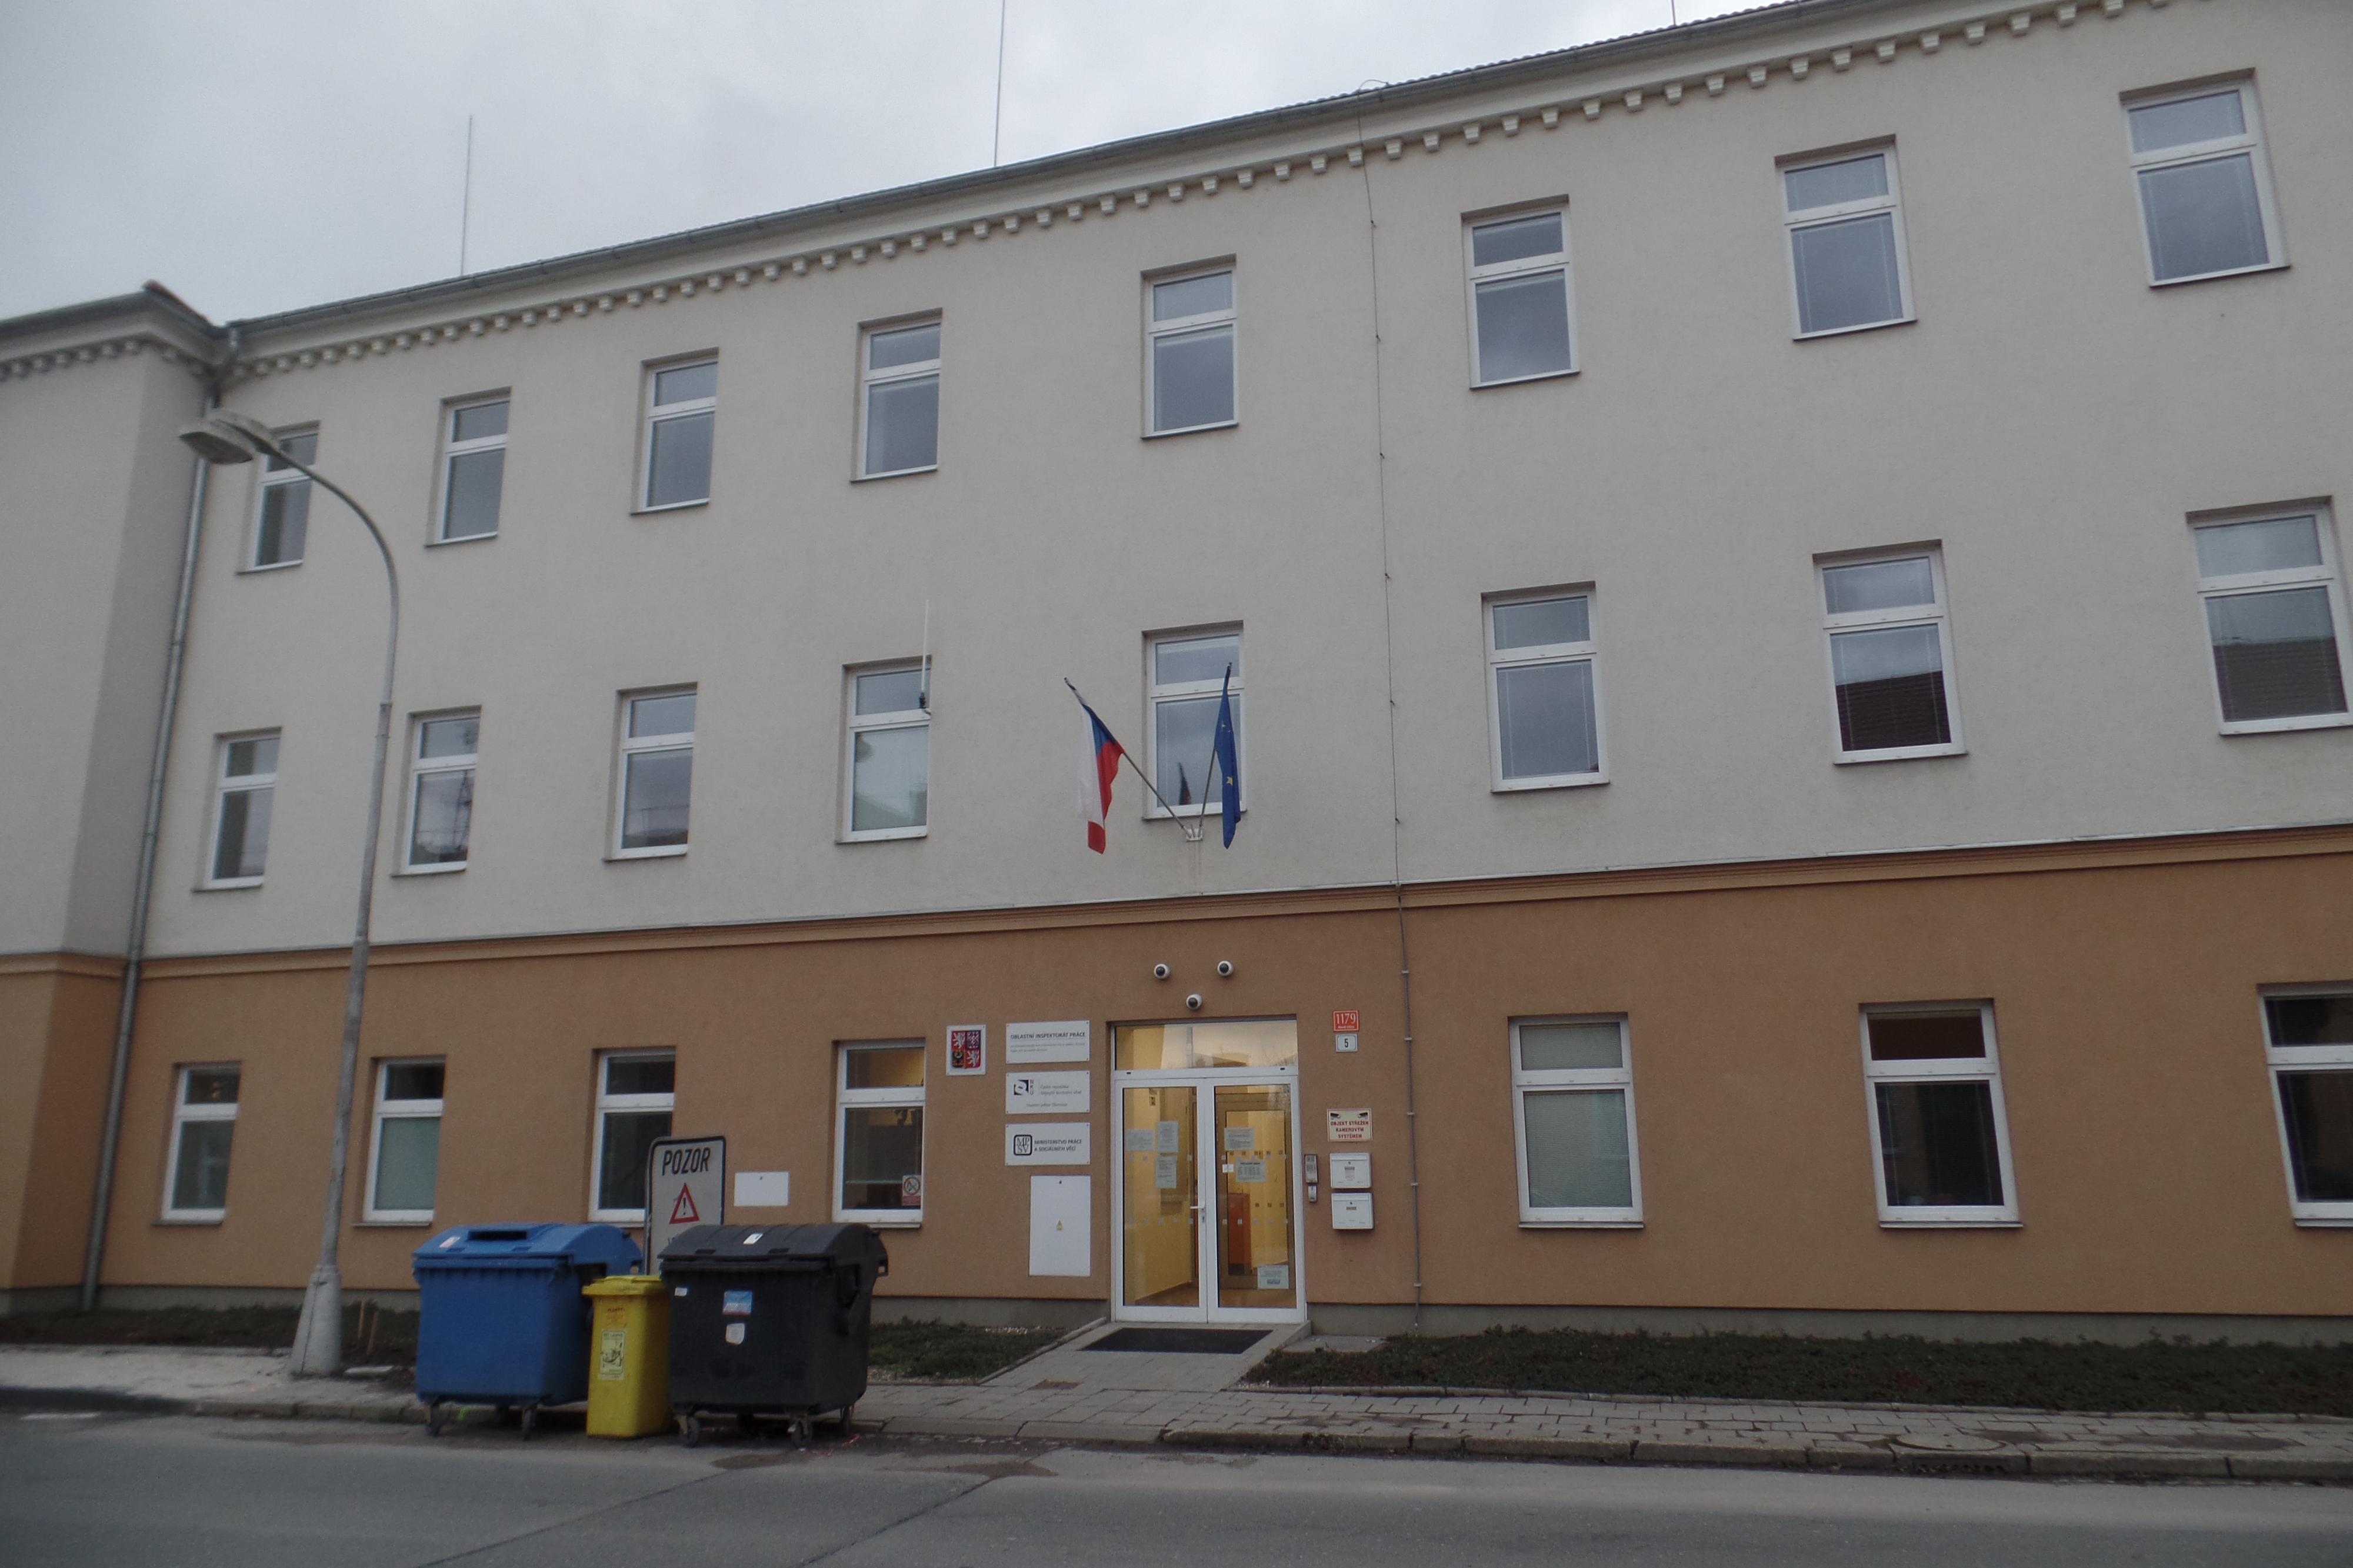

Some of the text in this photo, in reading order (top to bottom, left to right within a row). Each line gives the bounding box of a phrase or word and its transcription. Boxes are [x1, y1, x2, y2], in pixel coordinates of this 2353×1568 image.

[1336, 1013, 1356, 1024] 1179
[1344, 1038, 1349, 1047] 5
[662, 1147, 711, 1176] POZOR
